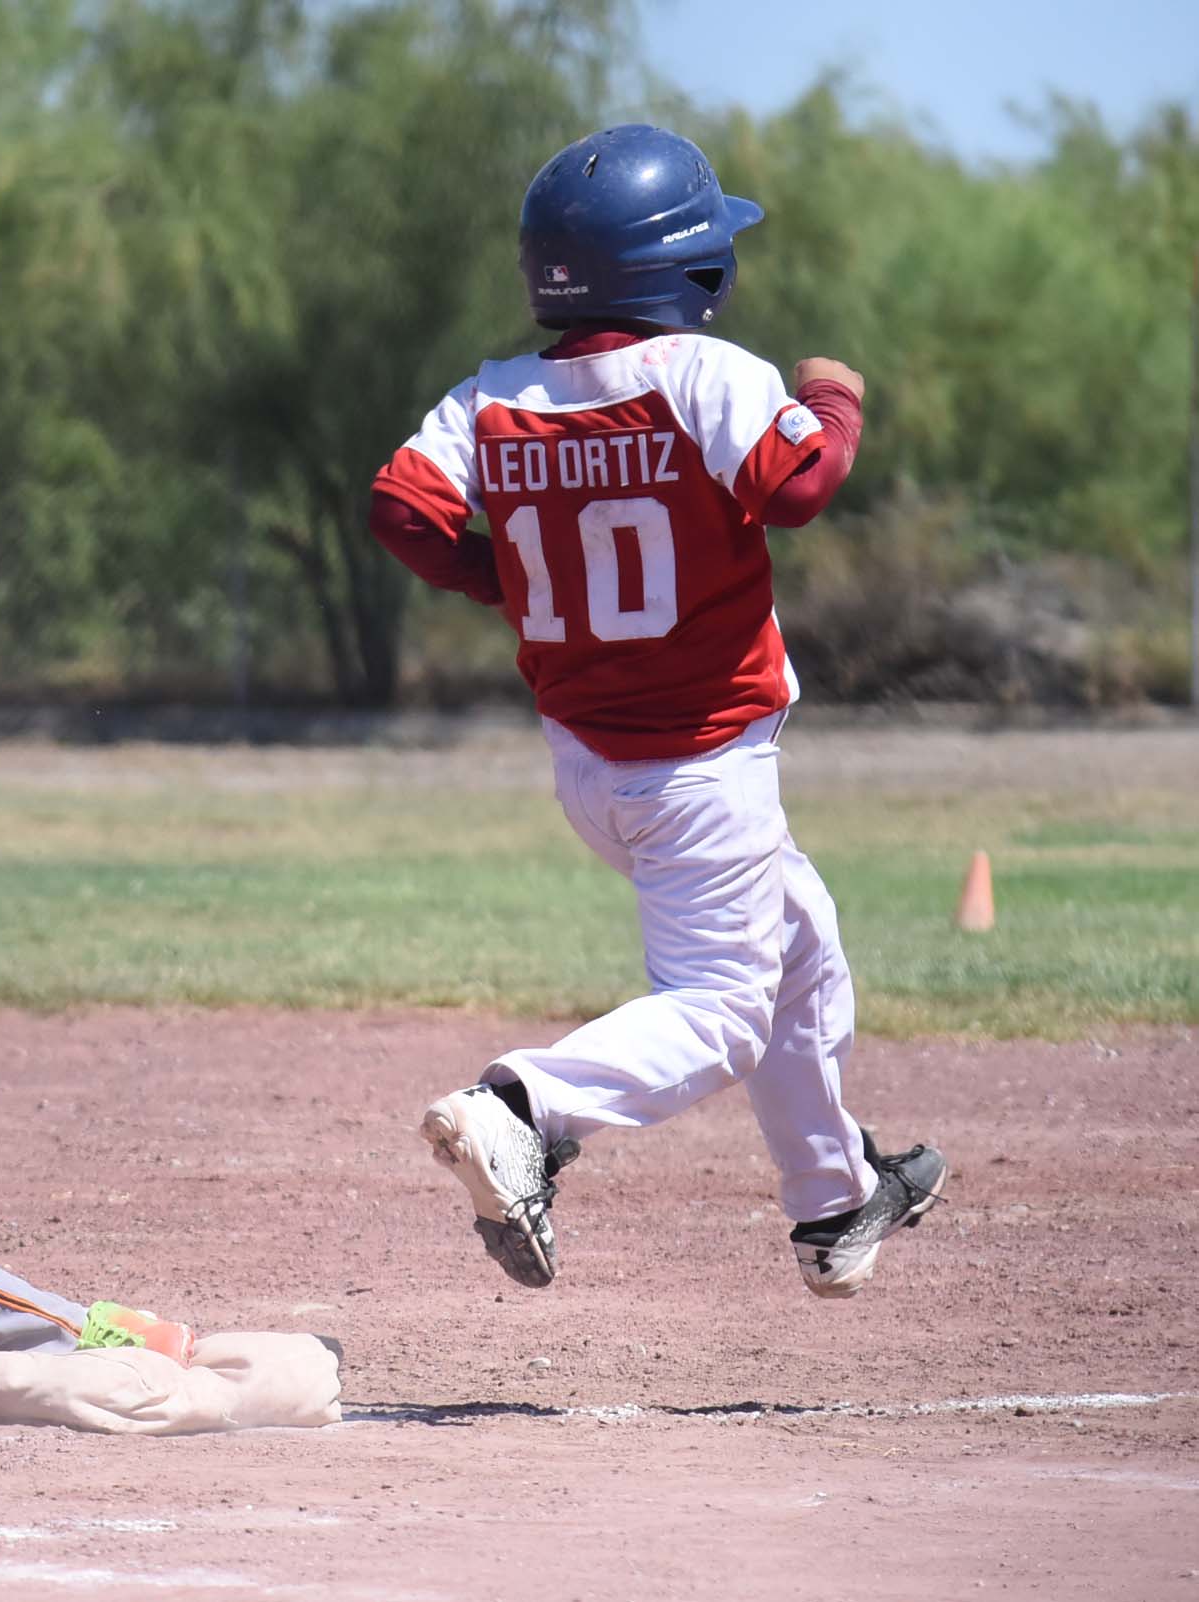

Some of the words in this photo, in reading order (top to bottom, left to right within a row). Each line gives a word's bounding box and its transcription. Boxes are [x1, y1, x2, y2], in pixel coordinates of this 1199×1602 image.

[480, 442, 548, 492] LEO
[558, 432, 679, 489] ORTIZ
[505, 497, 678, 642] 10
